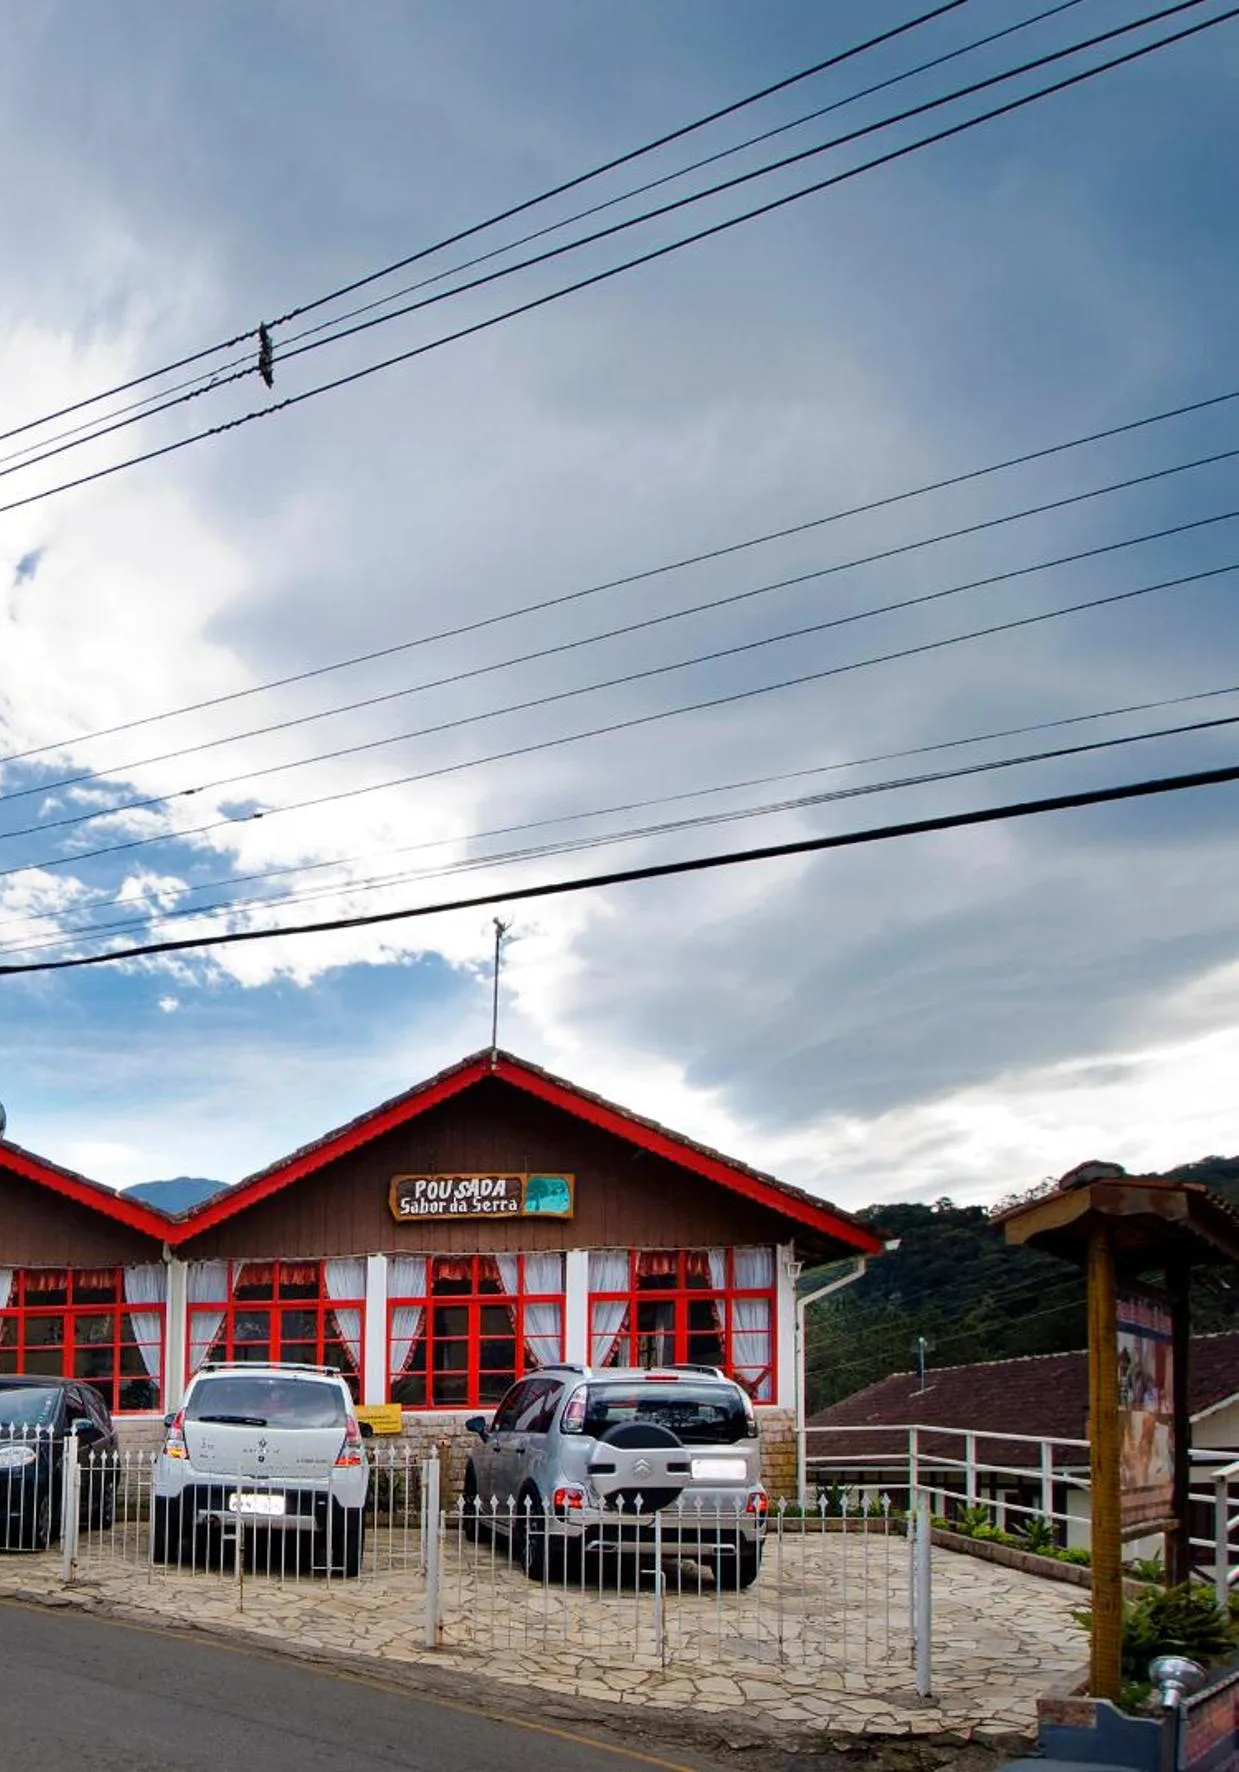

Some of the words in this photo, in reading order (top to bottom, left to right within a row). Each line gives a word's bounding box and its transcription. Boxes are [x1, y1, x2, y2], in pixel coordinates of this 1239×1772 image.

[415, 1178, 506, 1200] POUSADA
[400, 1198, 447, 1215] Sabor
[450, 1197, 468, 1213] da
[472, 1196, 518, 1213] Serra
